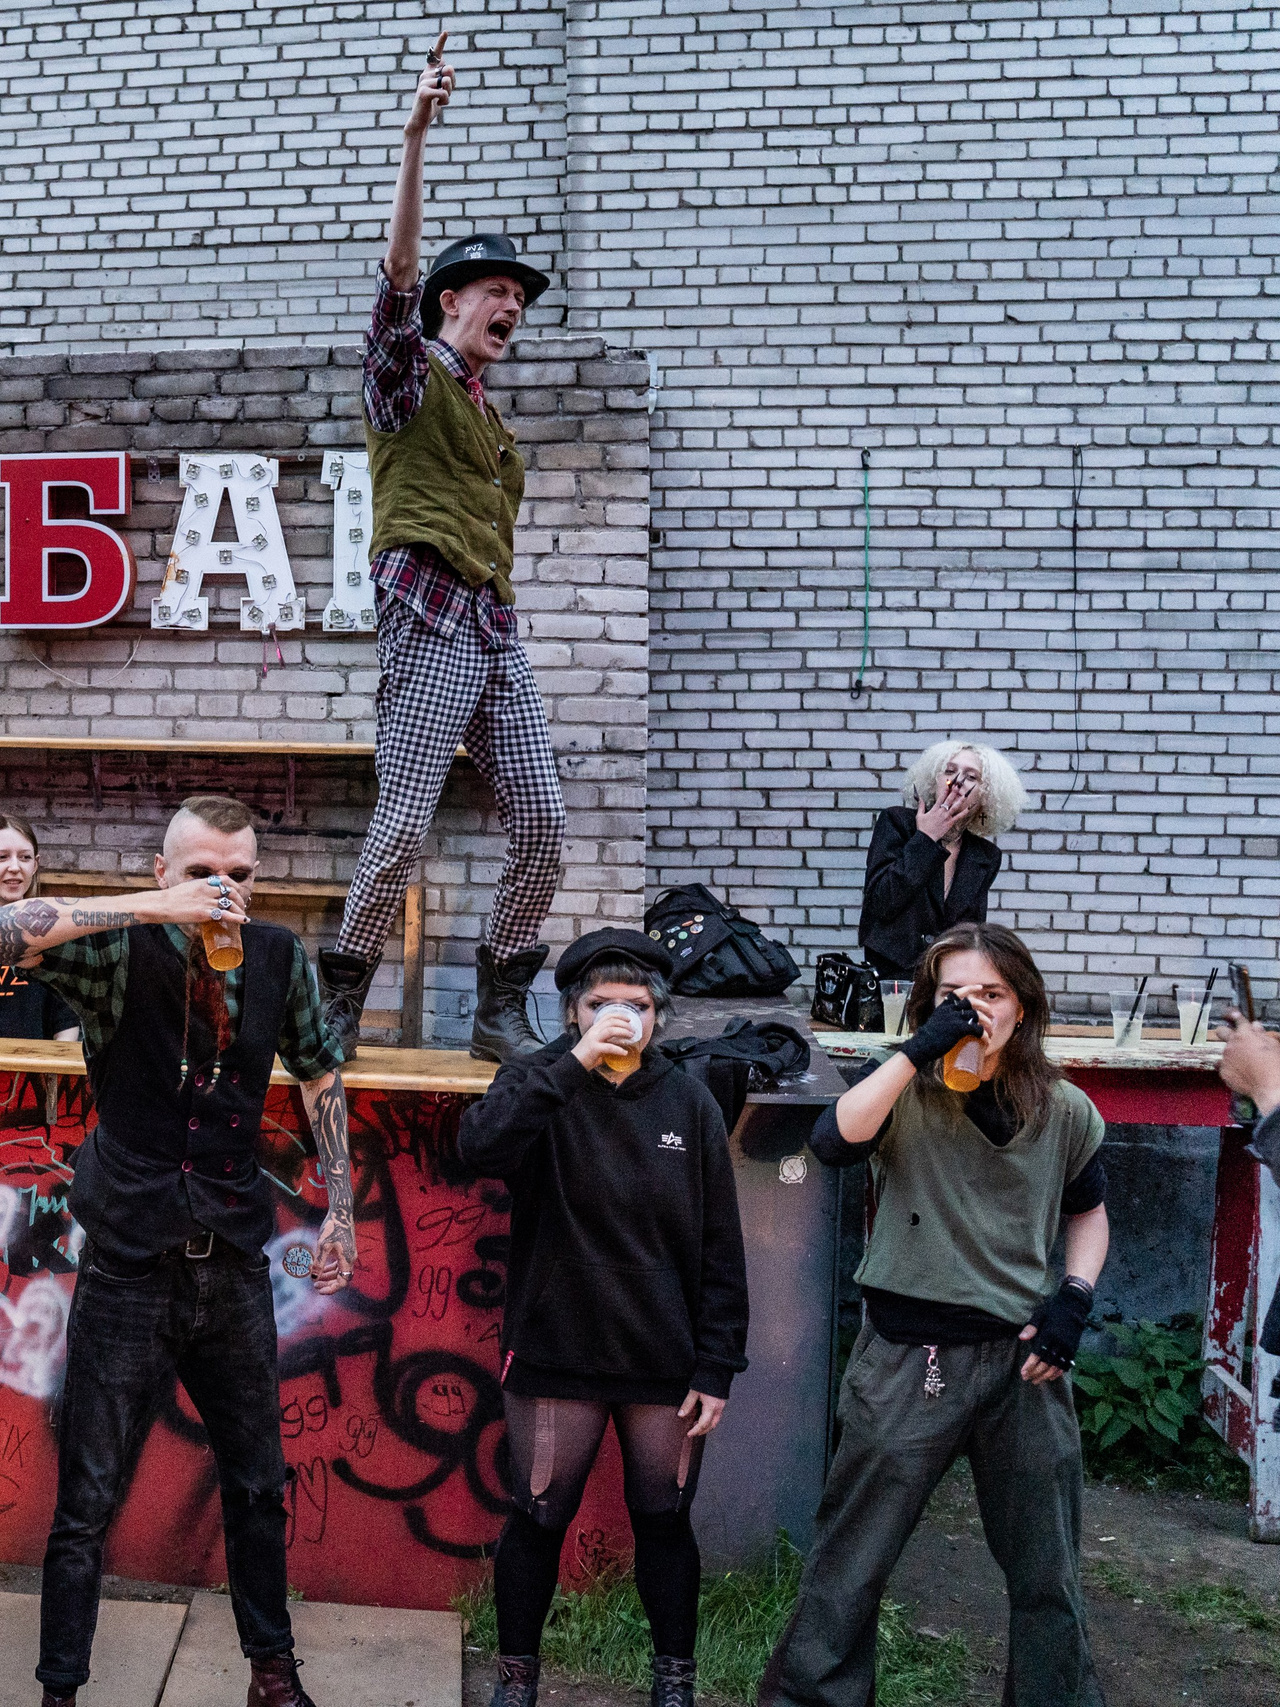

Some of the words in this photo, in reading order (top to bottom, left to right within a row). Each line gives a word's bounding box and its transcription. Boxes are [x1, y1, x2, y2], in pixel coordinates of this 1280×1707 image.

[72, 909, 140, 928] СИБИРЬ
[412, 1264, 452, 1321] 99
[281, 1395, 328, 1439] 99
[338, 1414, 378, 1459] 99
